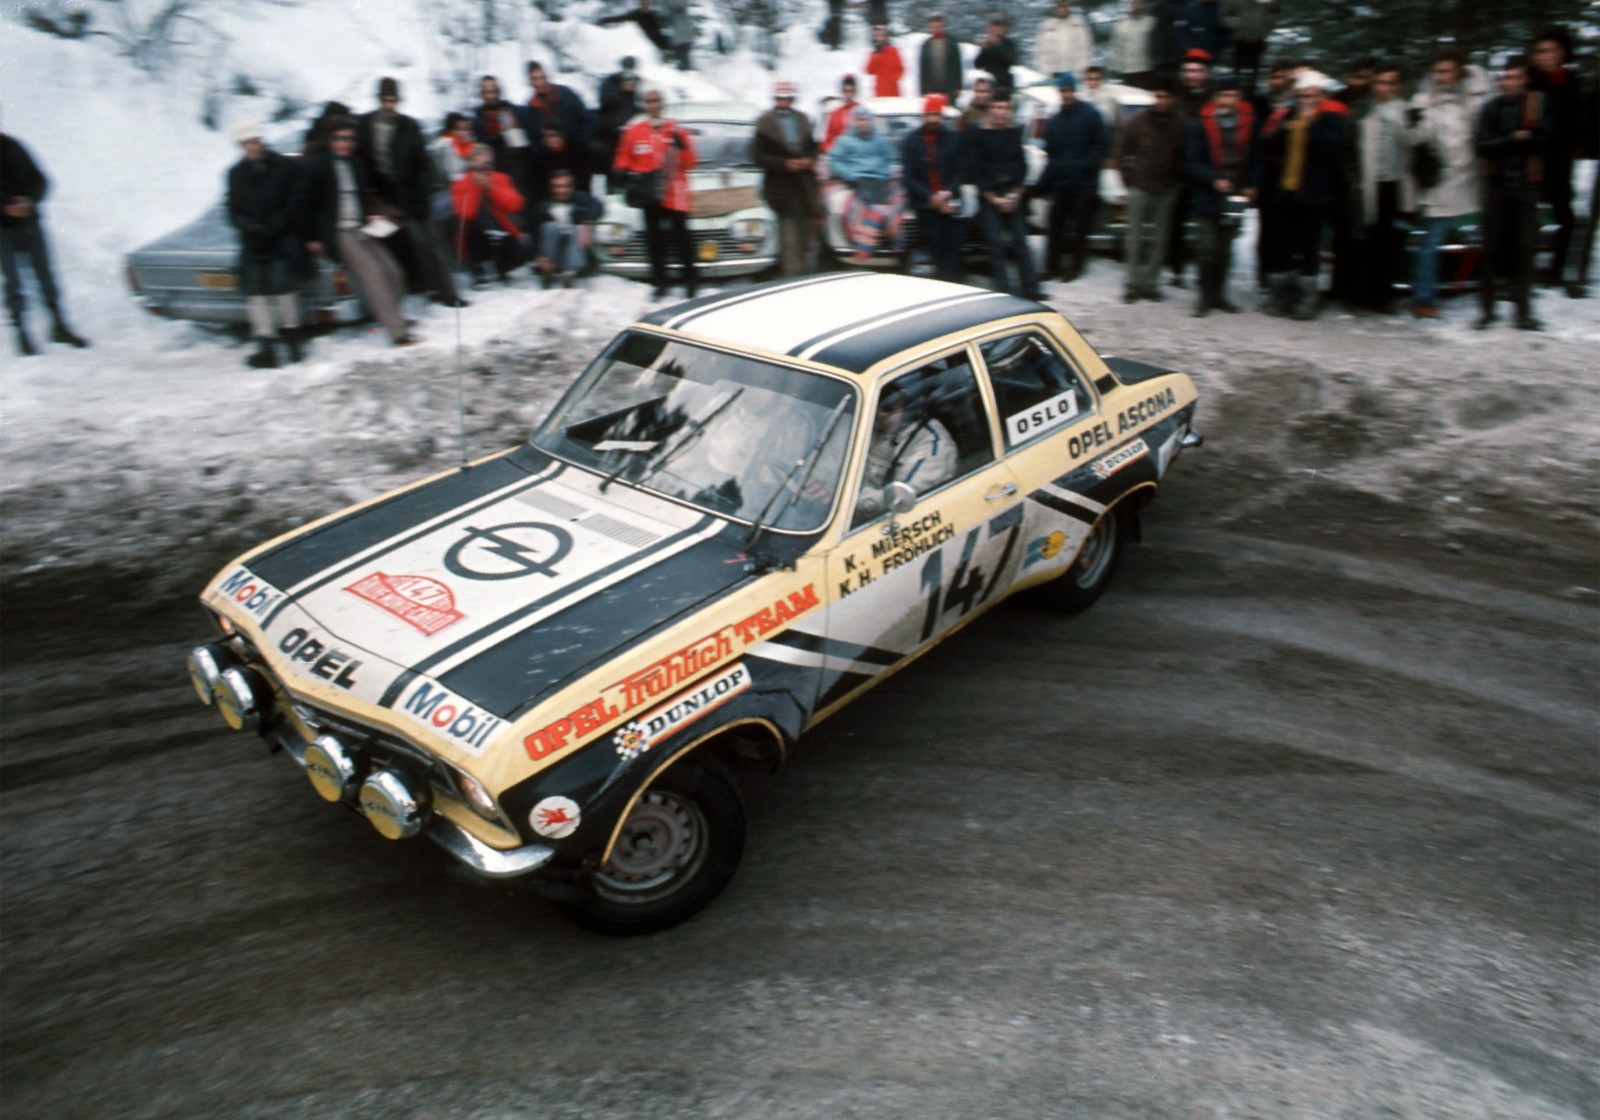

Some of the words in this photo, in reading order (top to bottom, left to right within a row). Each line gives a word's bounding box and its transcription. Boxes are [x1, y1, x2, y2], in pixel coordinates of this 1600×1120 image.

[1016, 399, 1070, 434] OSLO
[1068, 420, 1114, 459] OPEL
[1118, 387, 1177, 434] ASCONA
[220, 569, 284, 615] Mobil
[844, 554, 866, 573] K.
[920, 500, 1025, 644] 147
[279, 628, 362, 690] OPEL
[522, 696, 619, 761] OPEL
[731, 583, 820, 644] TEAM
[404, 682, 500, 748] Mobil
[647, 669, 745, 736] DUNLOP
